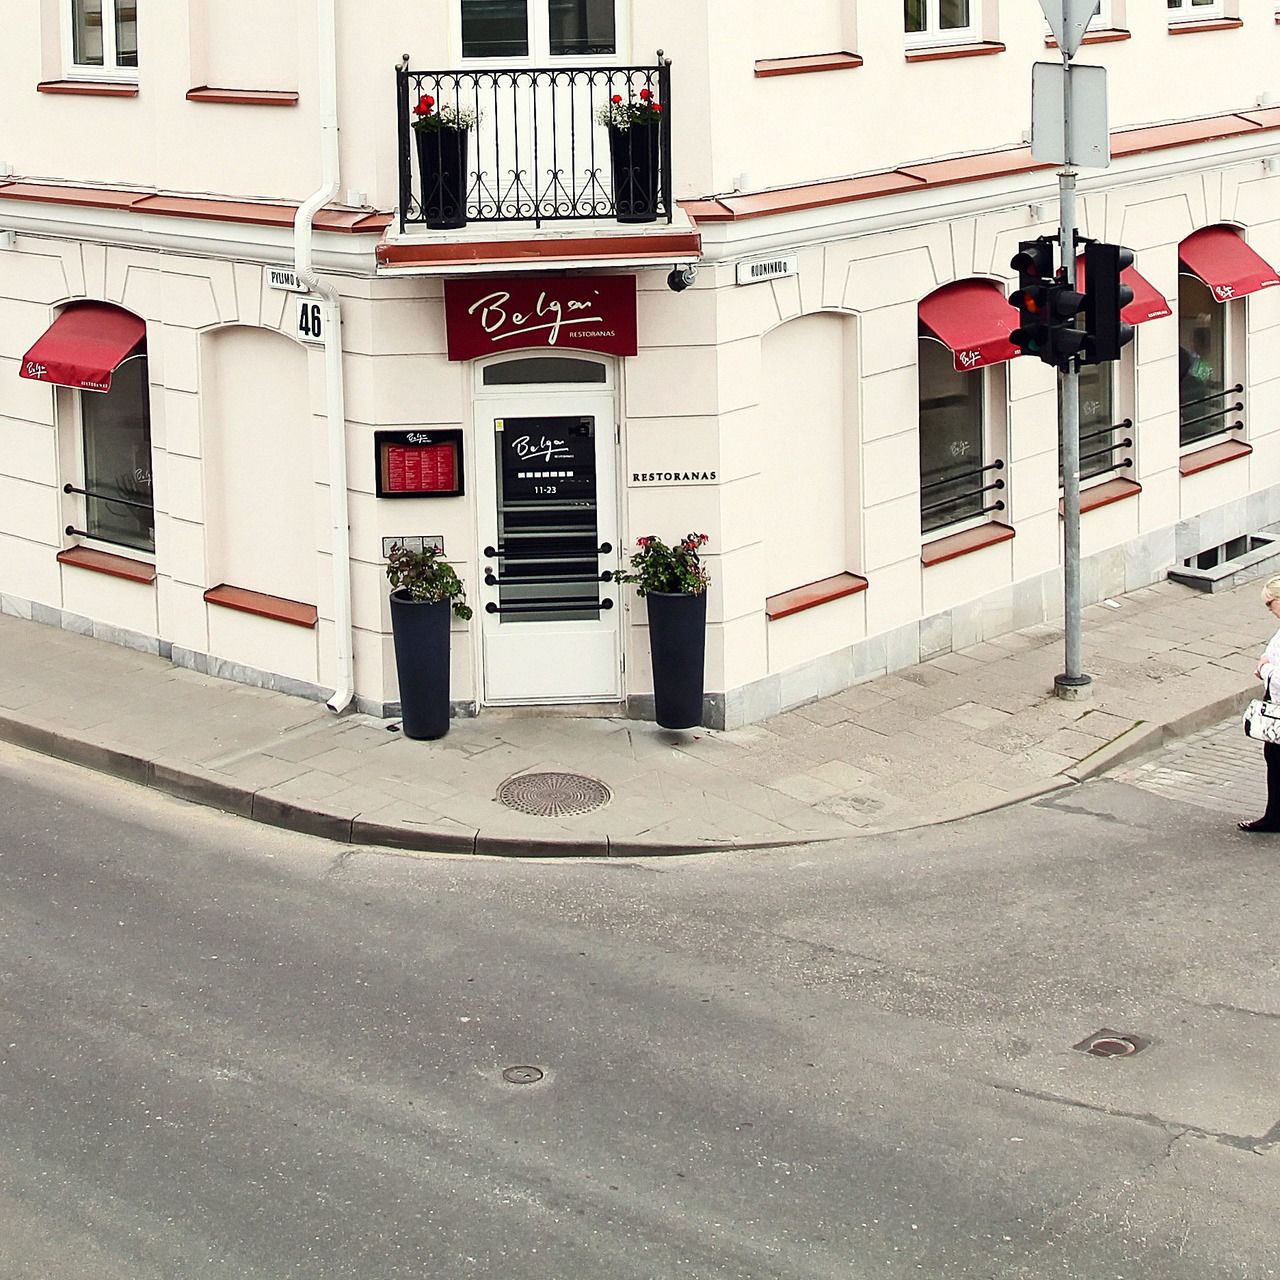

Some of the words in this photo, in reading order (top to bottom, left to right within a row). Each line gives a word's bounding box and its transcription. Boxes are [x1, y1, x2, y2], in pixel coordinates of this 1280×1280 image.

[299, 302, 322, 337] 46
[468, 290, 602, 345] Belgai
[569, 330, 616, 338] RESTORANAS
[632, 471, 717, 482] RESTORANAS
[534, 486, 557, 494] 11-23
